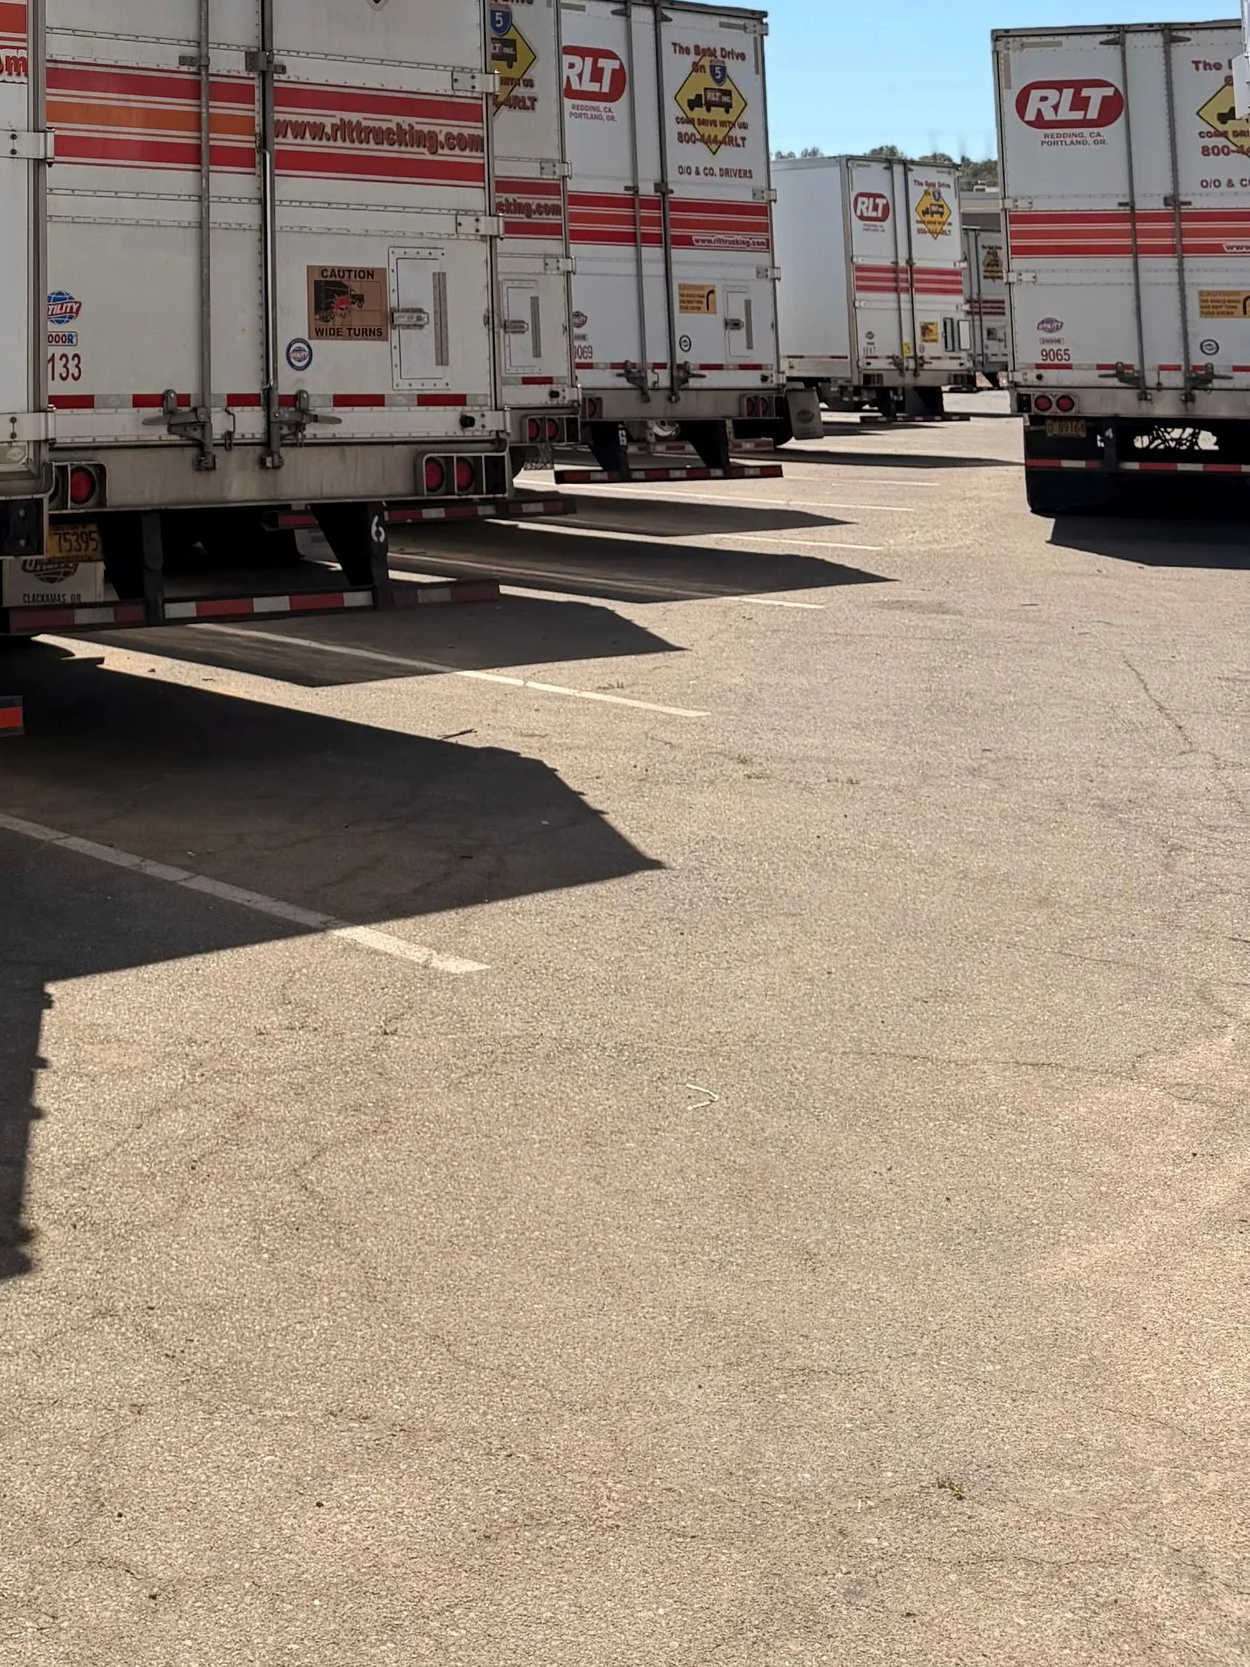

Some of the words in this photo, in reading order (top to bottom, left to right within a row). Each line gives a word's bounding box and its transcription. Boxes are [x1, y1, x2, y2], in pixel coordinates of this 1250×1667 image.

[494, 11, 504, 27] 5
[670, 41, 691, 57] The
[719, 47, 747, 62] Drive
[562, 54, 621, 94] RLT
[714, 67, 722, 80] 5
[1191, 60, 1222, 72] The
[1023, 87, 1115, 121] RLT
[274, 117, 485, 156] www.rlttrucking.com
[694, 166, 702, 176] &
[703, 167, 717, 177] CO.
[719, 168, 753, 179] DRIVERS
[856, 198, 887, 218] RLT
[321, 268, 375, 280] CAUTION
[48, 302, 80, 315] TILITY
[314, 327, 343, 337] WIDE
[346, 327, 383, 338] TURNS
[1040, 348, 1071, 362] 9065
[370, 514, 386, 543] 6
[53, 530, 99, 554] 75395
